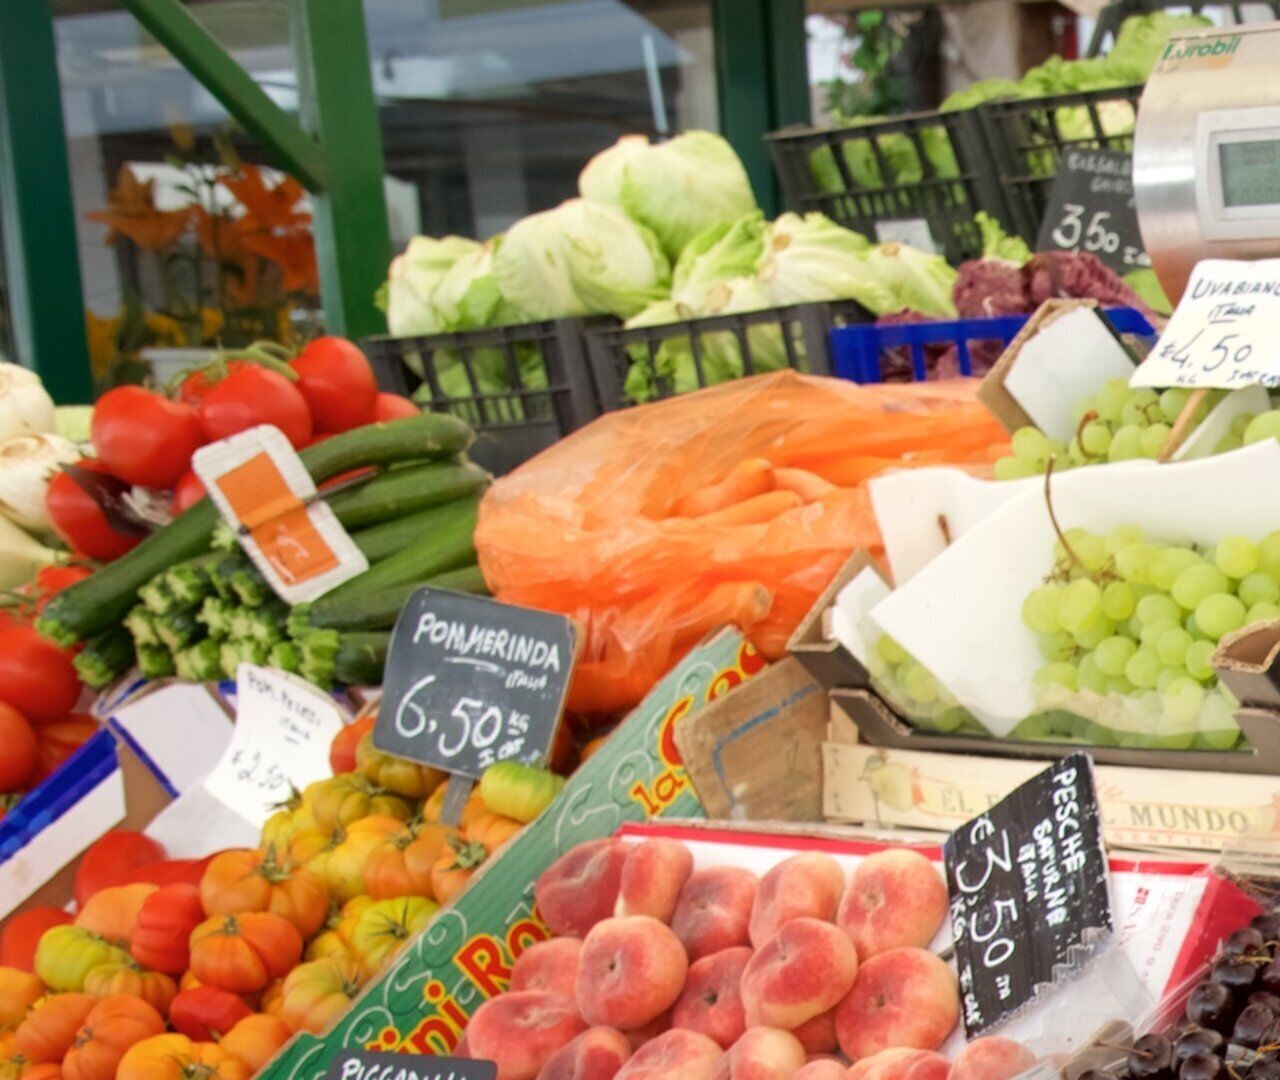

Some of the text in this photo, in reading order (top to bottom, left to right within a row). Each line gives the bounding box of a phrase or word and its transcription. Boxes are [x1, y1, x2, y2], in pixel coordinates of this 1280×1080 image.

[413, 612, 560, 672] POMMERINDA
[505, 669, 548, 691] ITALIA
[396, 674, 531, 758] 6,50 KG
[1052, 767, 1087, 873] PESCHE
[1130, 803, 1249, 834] MUNDO
[1016, 842, 1039, 903] ITALIA
[1032, 818, 1069, 928] SATURNE
